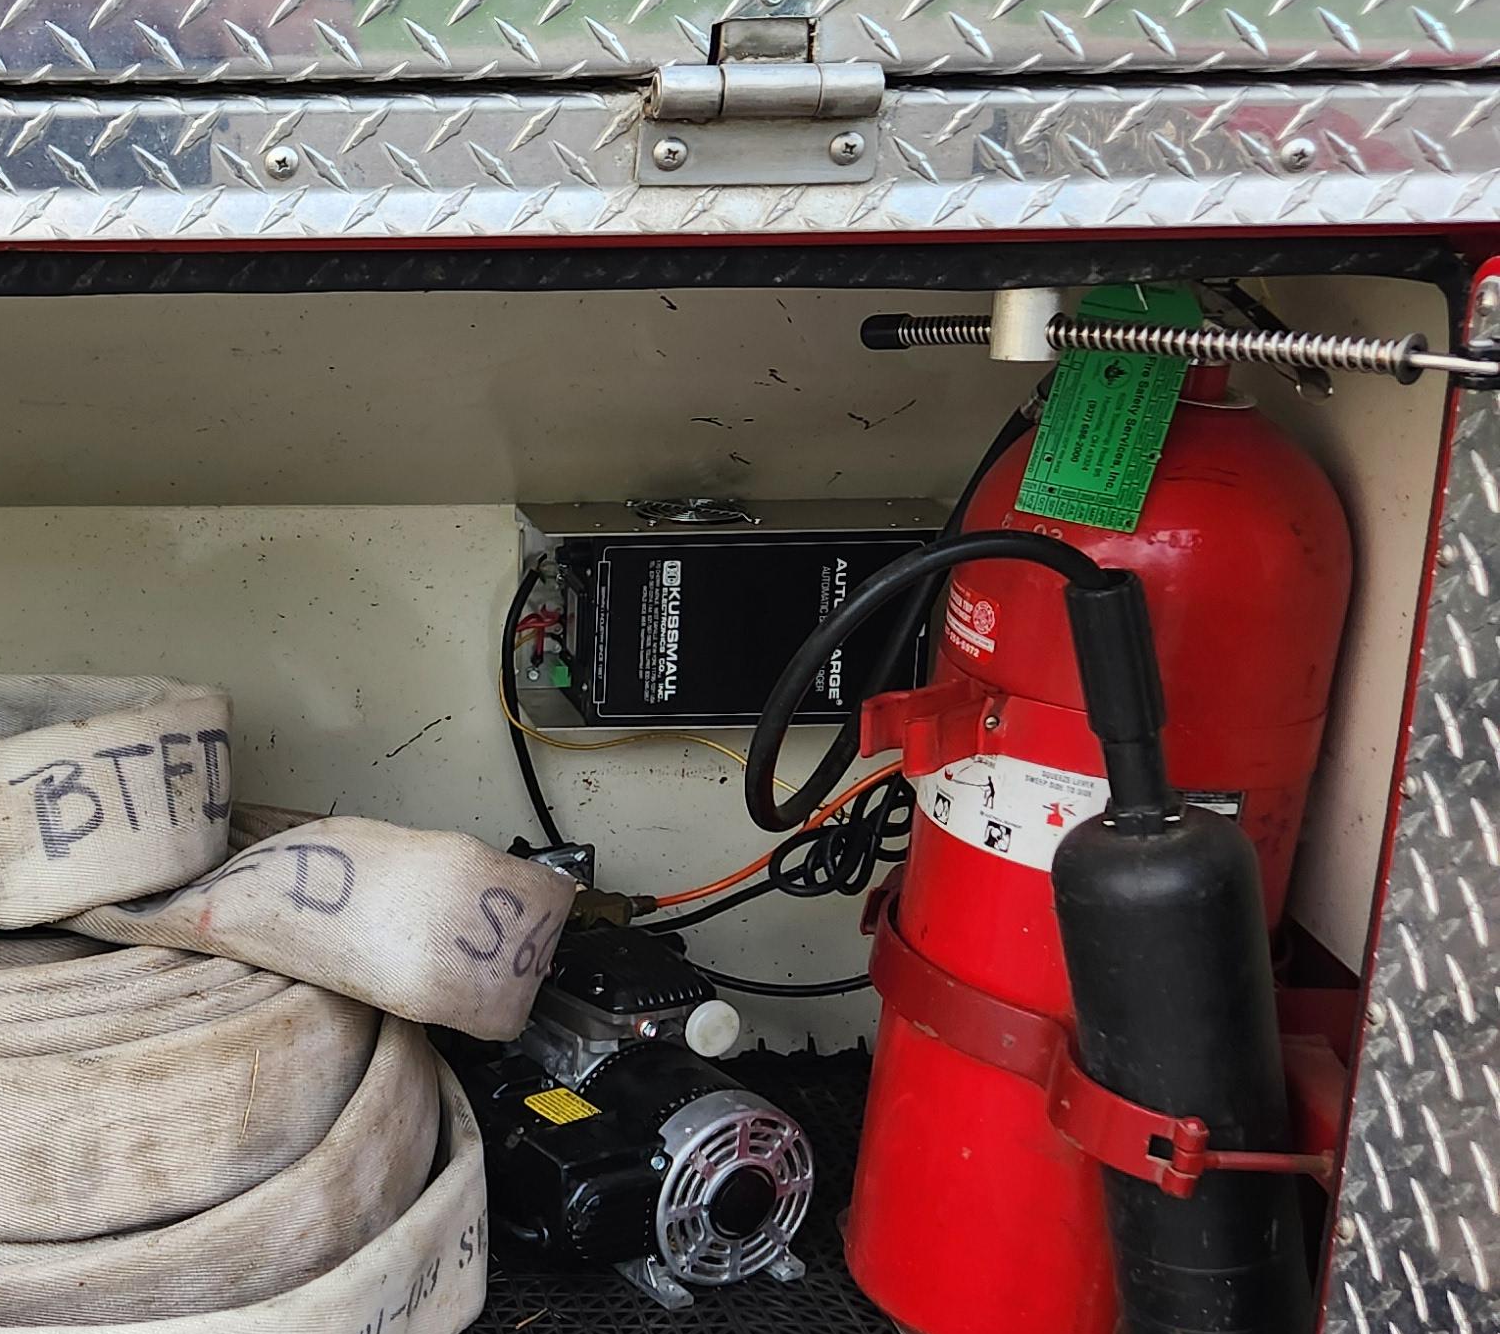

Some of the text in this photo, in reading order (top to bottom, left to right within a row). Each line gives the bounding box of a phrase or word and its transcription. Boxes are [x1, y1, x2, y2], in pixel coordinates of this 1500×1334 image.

[1140, 353, 1157, 378] Fire
[1081, 398, 1098, 423] (937)
[1126, 379, 1149, 416] Safety
[1103, 470, 1119, 493] Inc.
[819, 565, 830, 613] AUTOMATIC
[659, 587, 668, 653] ELECTRONICS
[663, 587, 680, 701] KUSSMAUL
